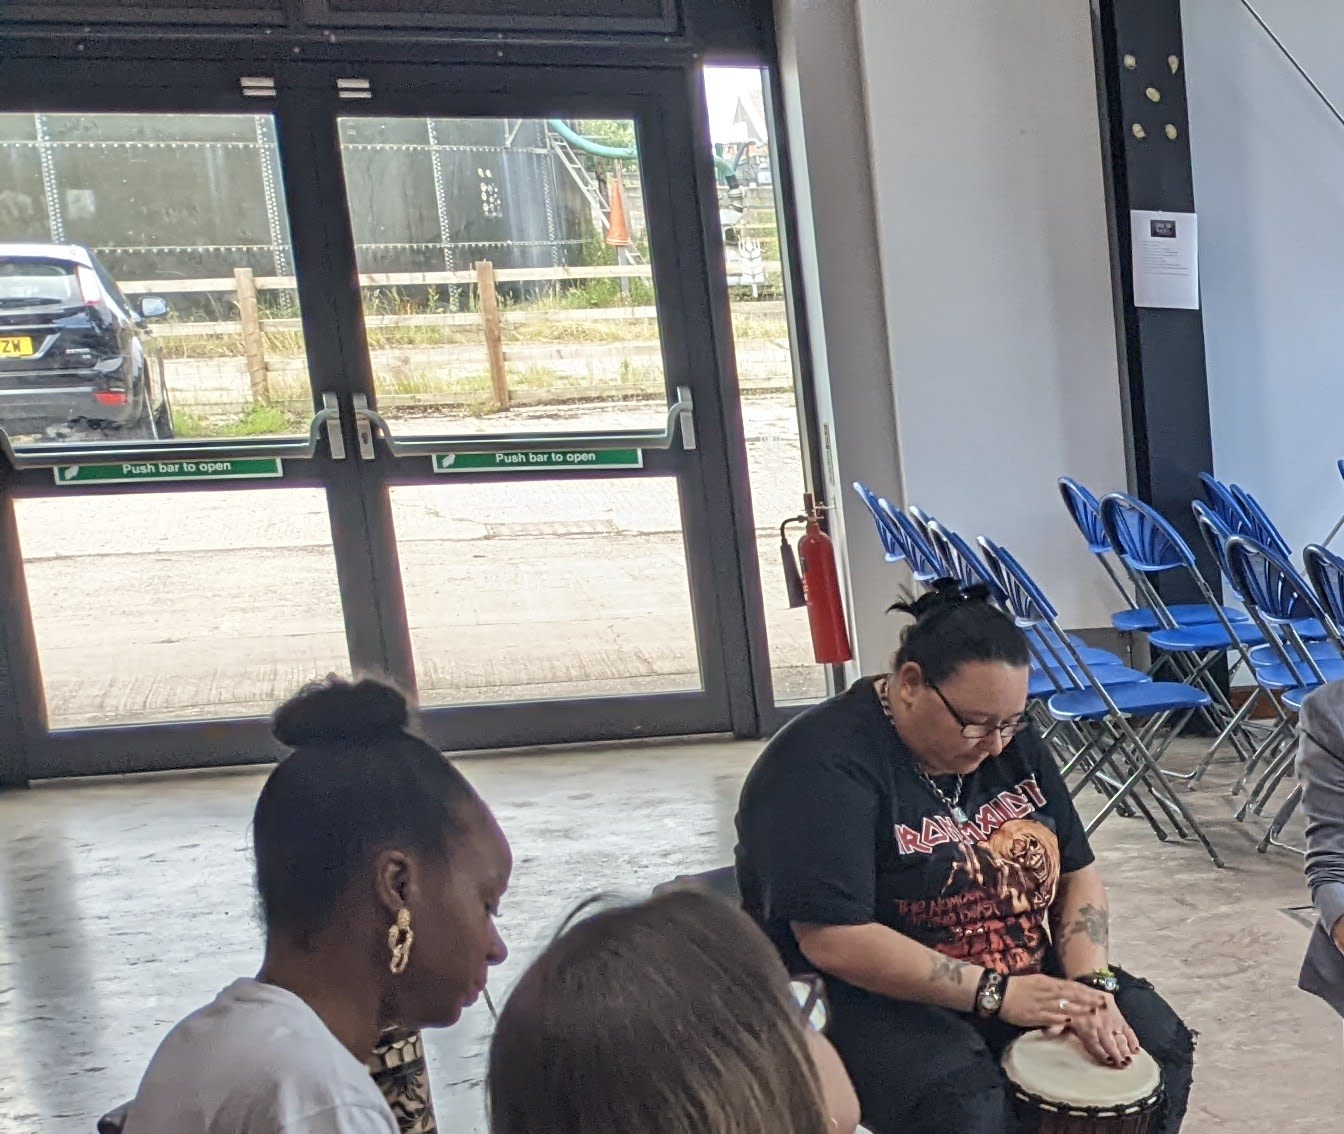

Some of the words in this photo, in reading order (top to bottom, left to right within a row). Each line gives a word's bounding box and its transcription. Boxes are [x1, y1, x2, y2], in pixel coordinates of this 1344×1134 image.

[496, 452, 526, 463] Push
[529, 452, 548, 462] bar
[551, 452, 564, 462] to
[566, 452, 596, 464] open
[122, 463, 156, 475] Push
[159, 462, 180, 473] bar
[183, 462, 196, 472] to
[199, 461, 232, 474] open
